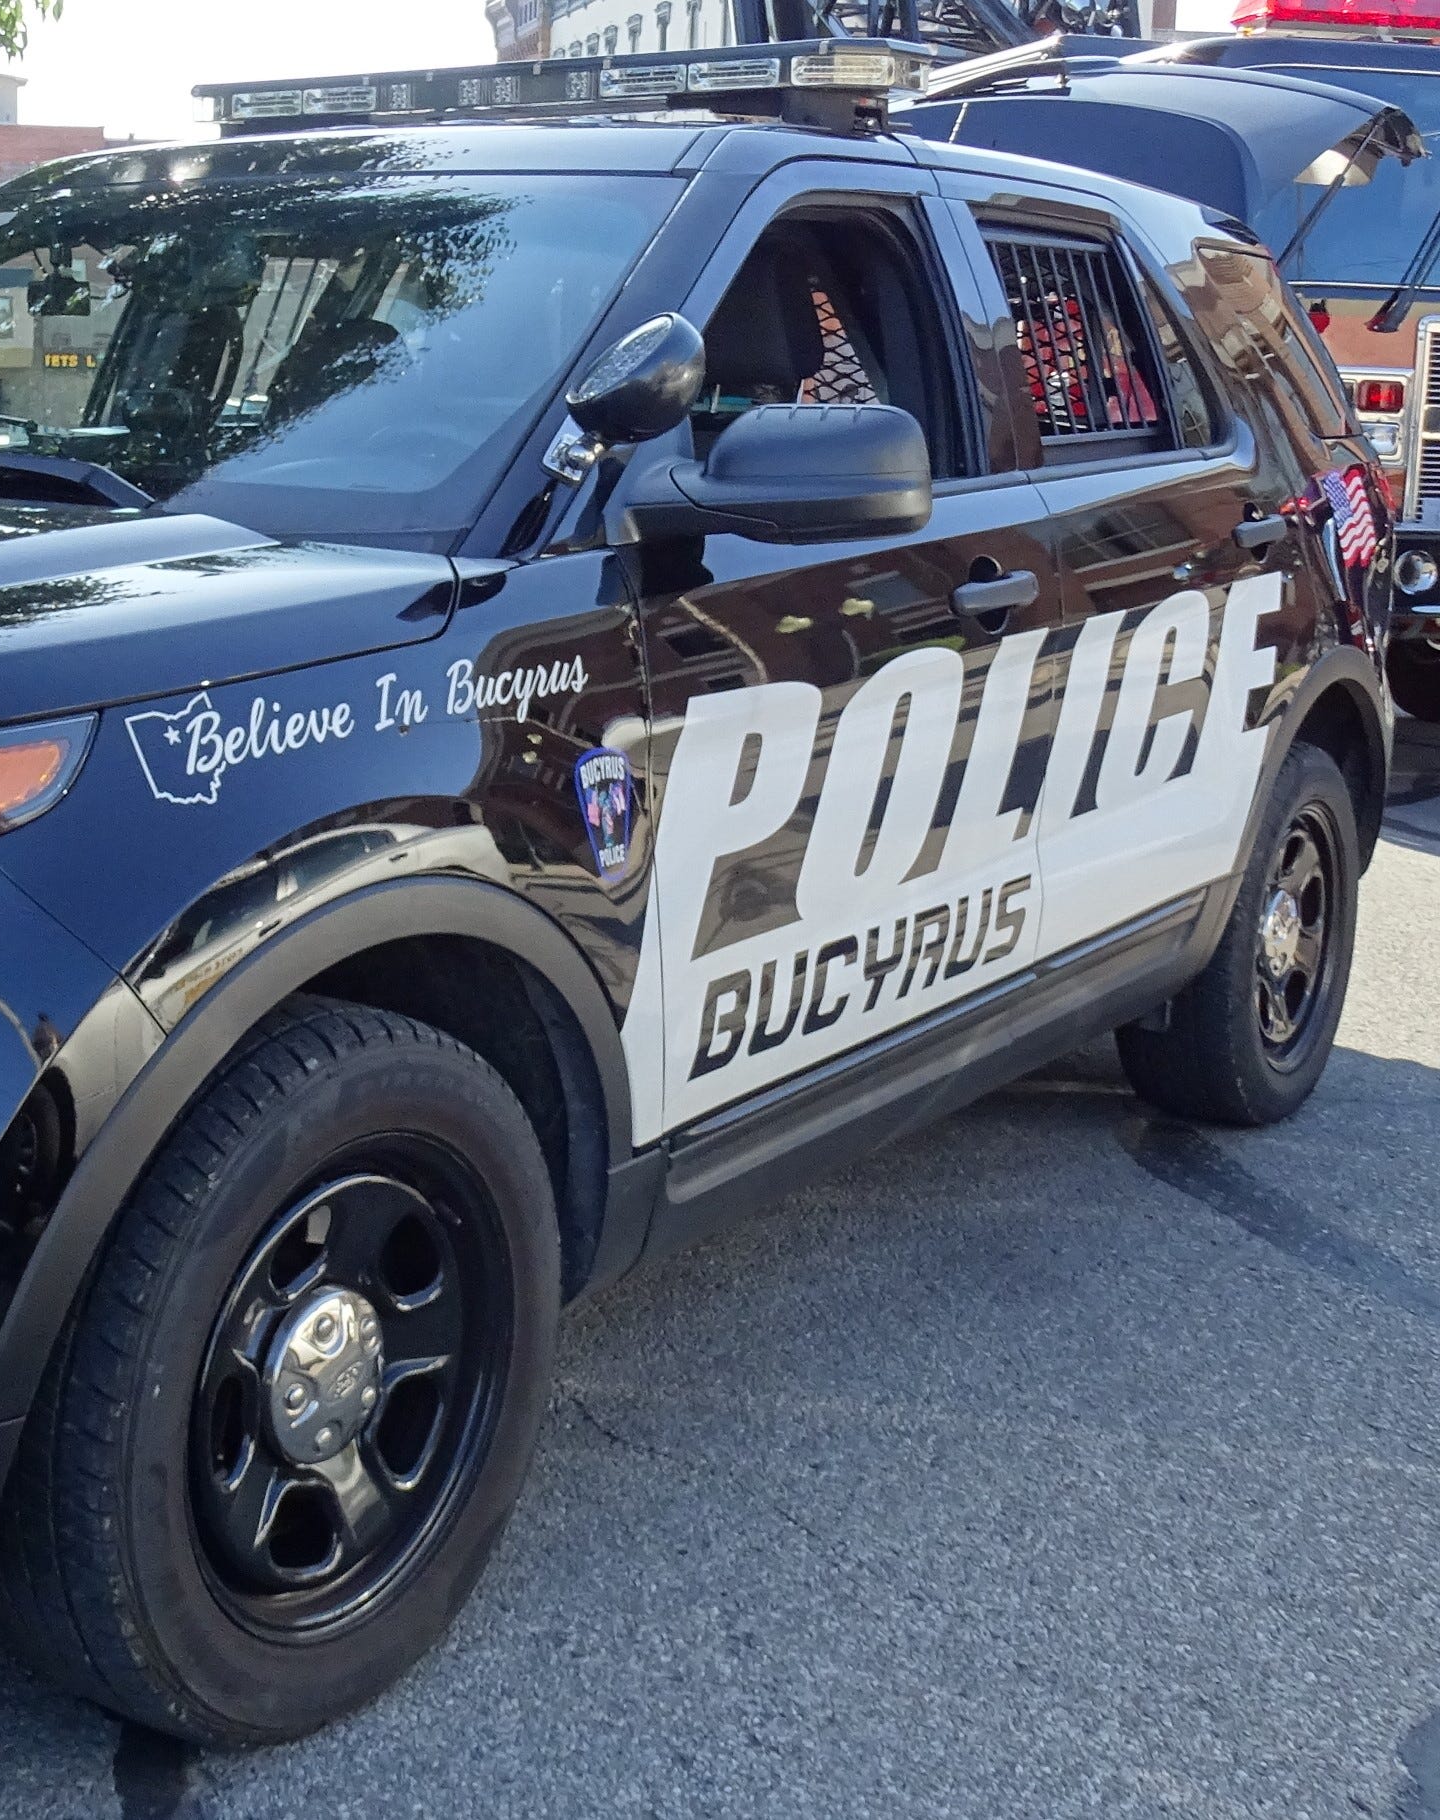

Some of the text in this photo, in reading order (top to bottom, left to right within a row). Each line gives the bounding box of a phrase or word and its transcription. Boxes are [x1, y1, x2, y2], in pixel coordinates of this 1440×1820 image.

[186, 654, 589, 775] Believe In Bucyrus
[579, 755, 626, 790] BUCYRUS
[660, 571, 1282, 960] POLICE
[599, 843, 626, 868] POLICE
[688, 875, 1032, 1082] BUCYRUS
